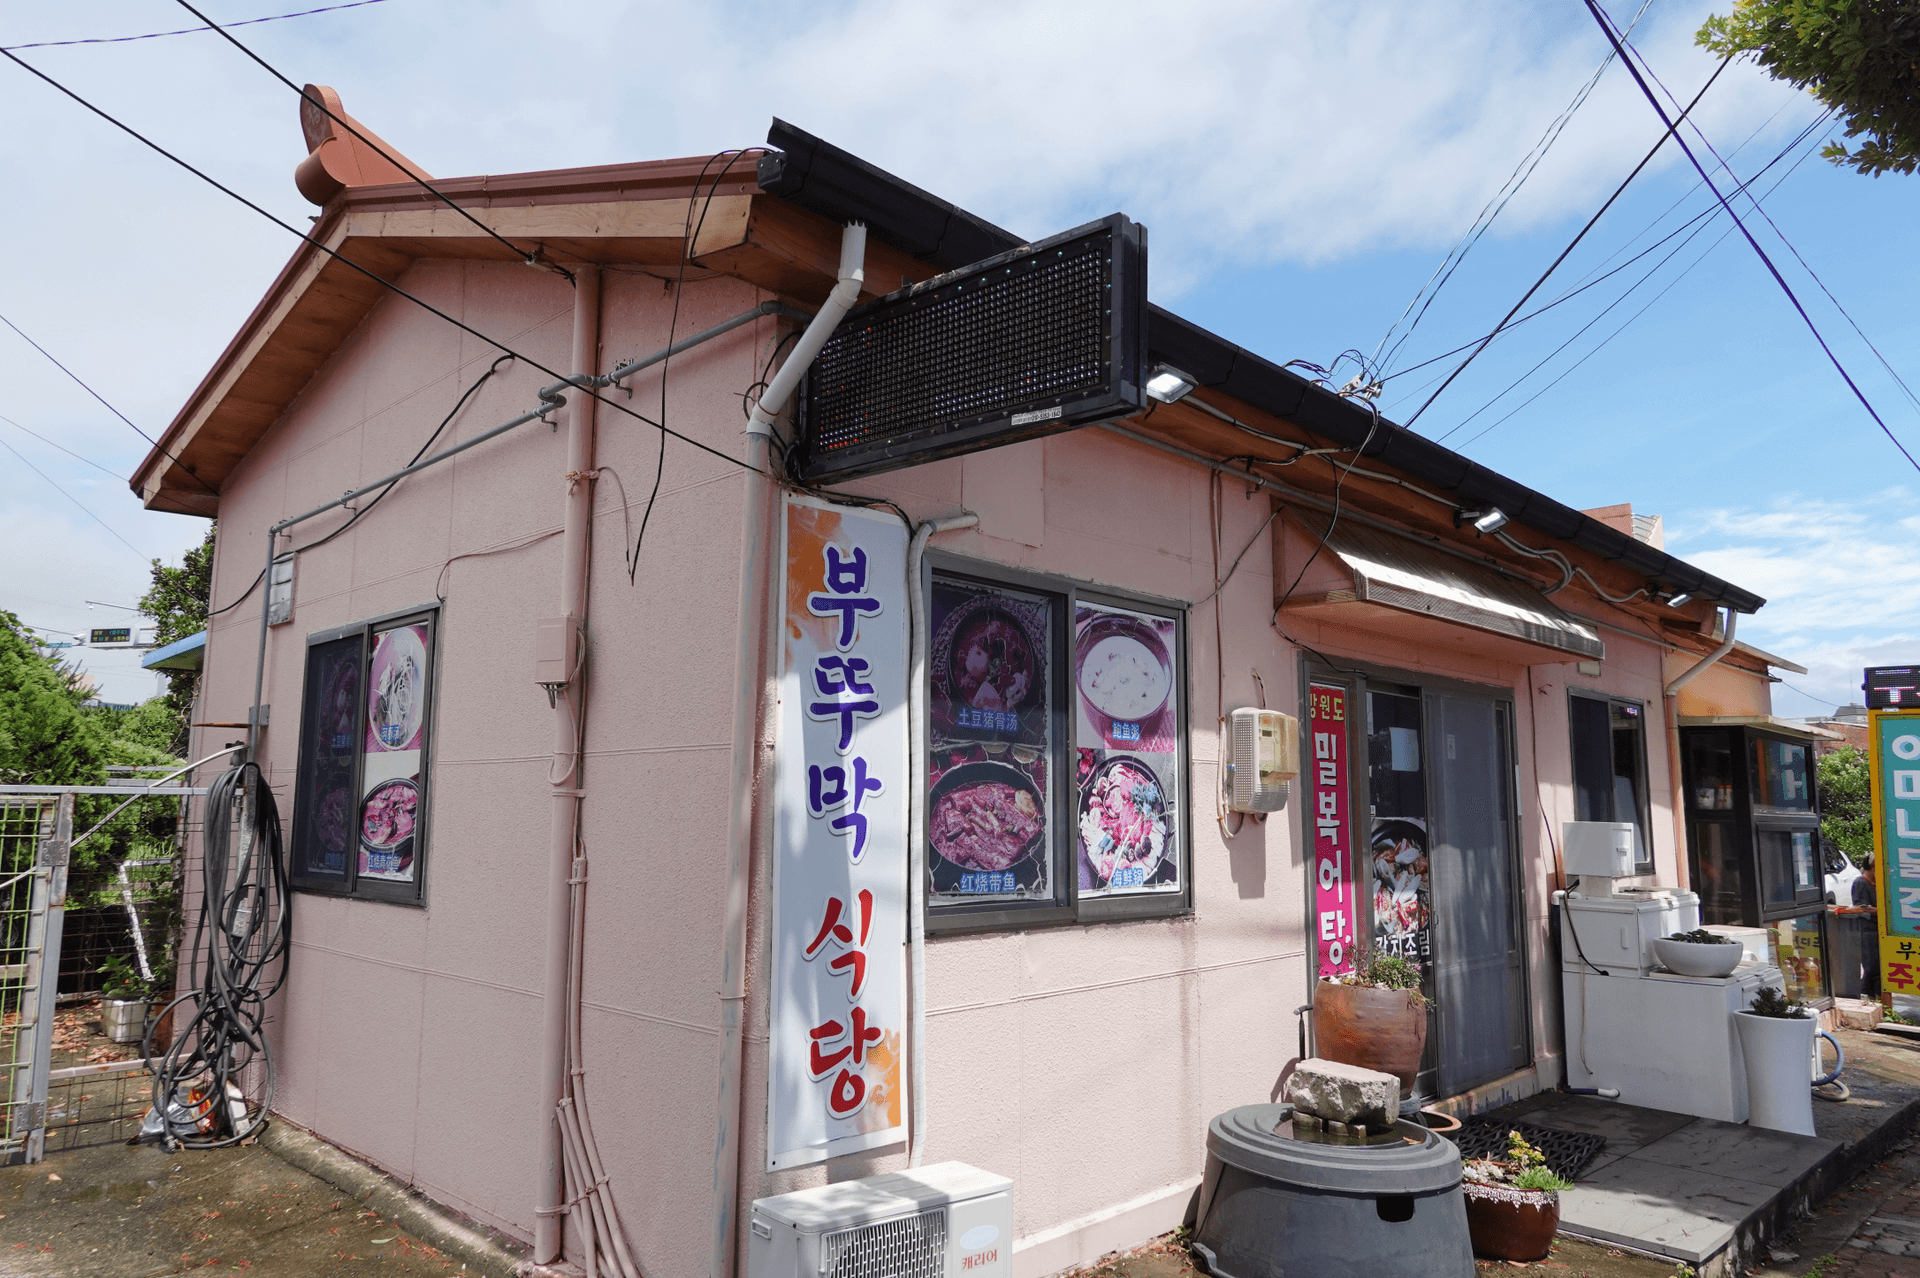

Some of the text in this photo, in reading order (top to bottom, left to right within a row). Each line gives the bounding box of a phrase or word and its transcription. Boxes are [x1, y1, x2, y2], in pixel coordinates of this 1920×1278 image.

[958, 708, 1019, 731] 土豆猪骨汤
[1112, 722, 1140, 741] 鲍鱼粥
[804, 544, 884, 1114] 부뚜막 식당
[960, 871, 1016, 892] 红烧带鱼
[1113, 869, 1143, 887] 海鲜锅
[961, 1249, 997, 1270] 캐리어
